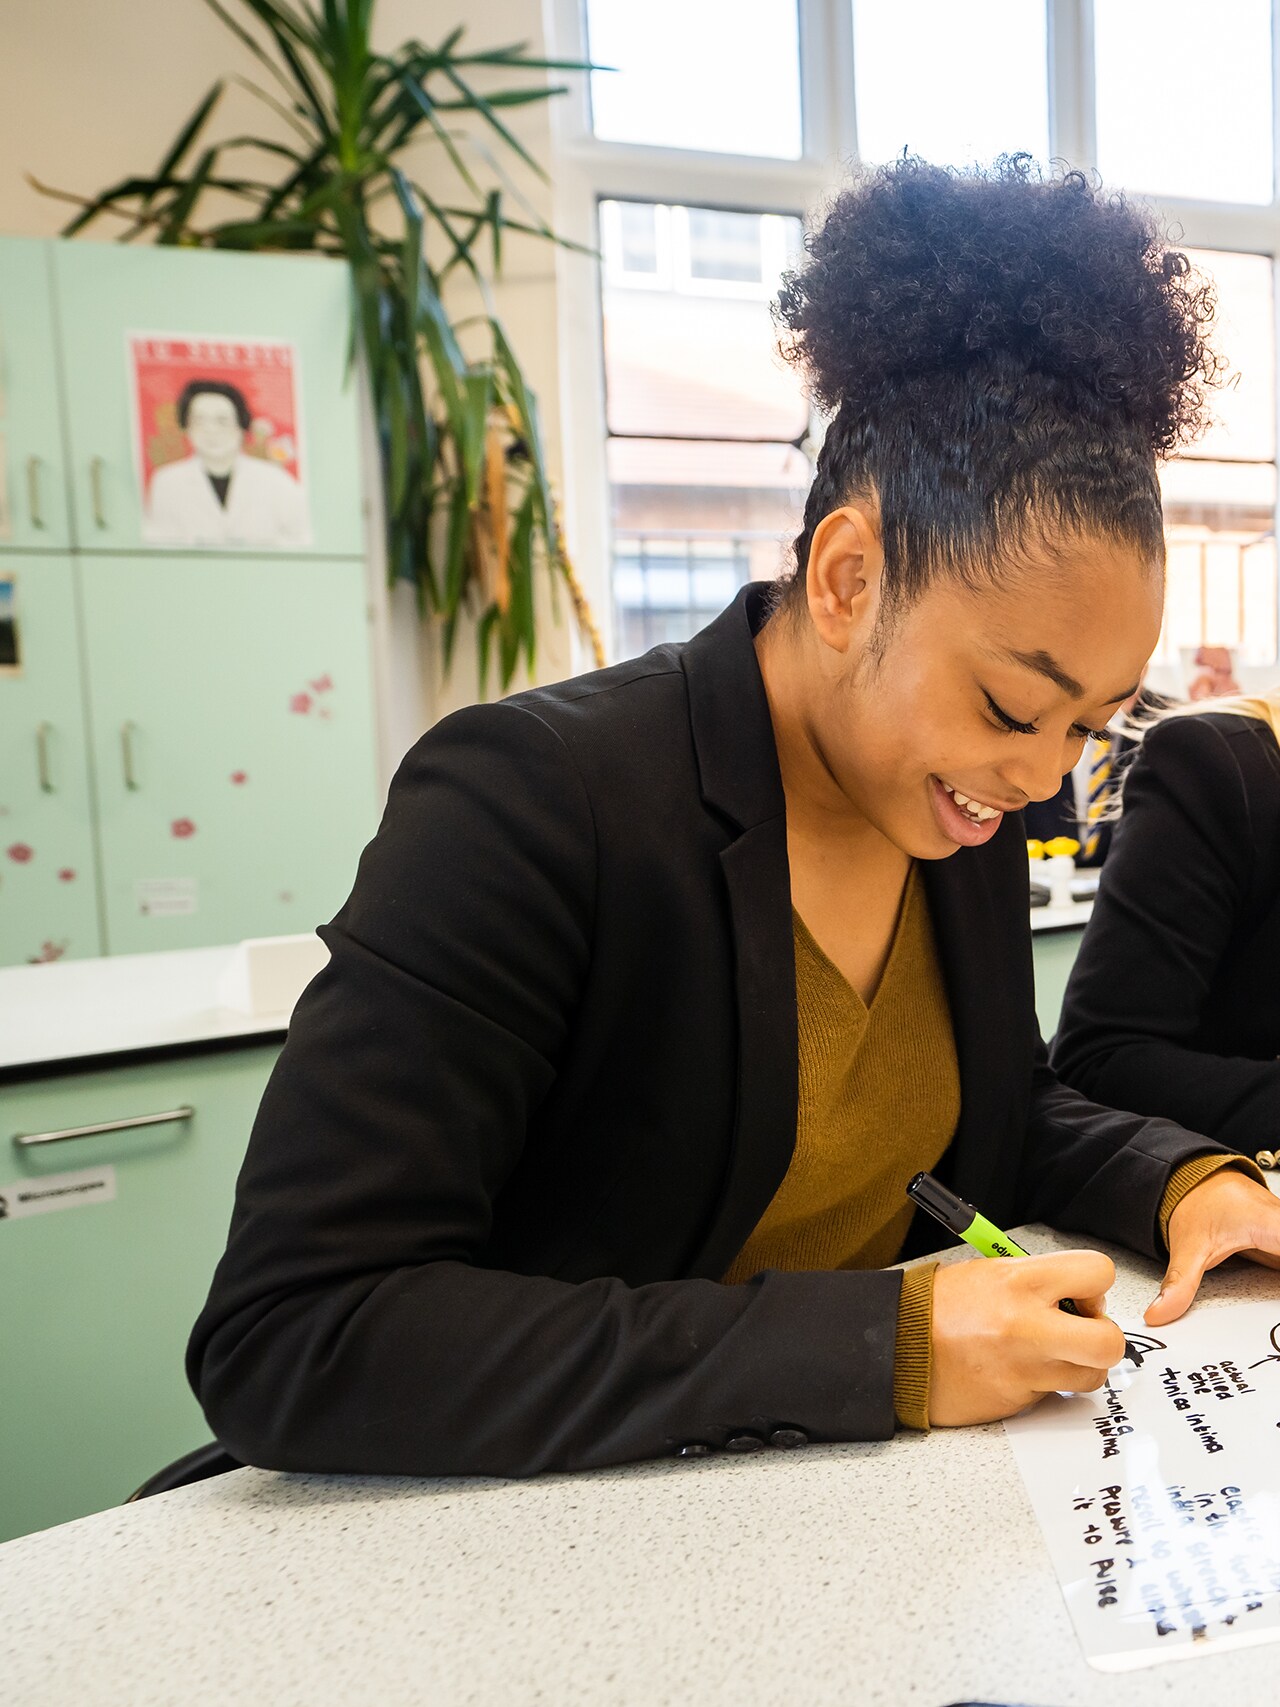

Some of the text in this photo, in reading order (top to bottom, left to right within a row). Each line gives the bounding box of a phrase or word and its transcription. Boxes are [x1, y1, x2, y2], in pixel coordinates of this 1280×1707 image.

[1187, 1372, 1212, 1394] the
[1202, 1365, 1234, 1400] called
[1185, 1413, 1224, 1454] intima
[1072, 1497, 1096, 1511] it
[1193, 1493, 1217, 1509] in
[1083, 1524, 1102, 1544] to
